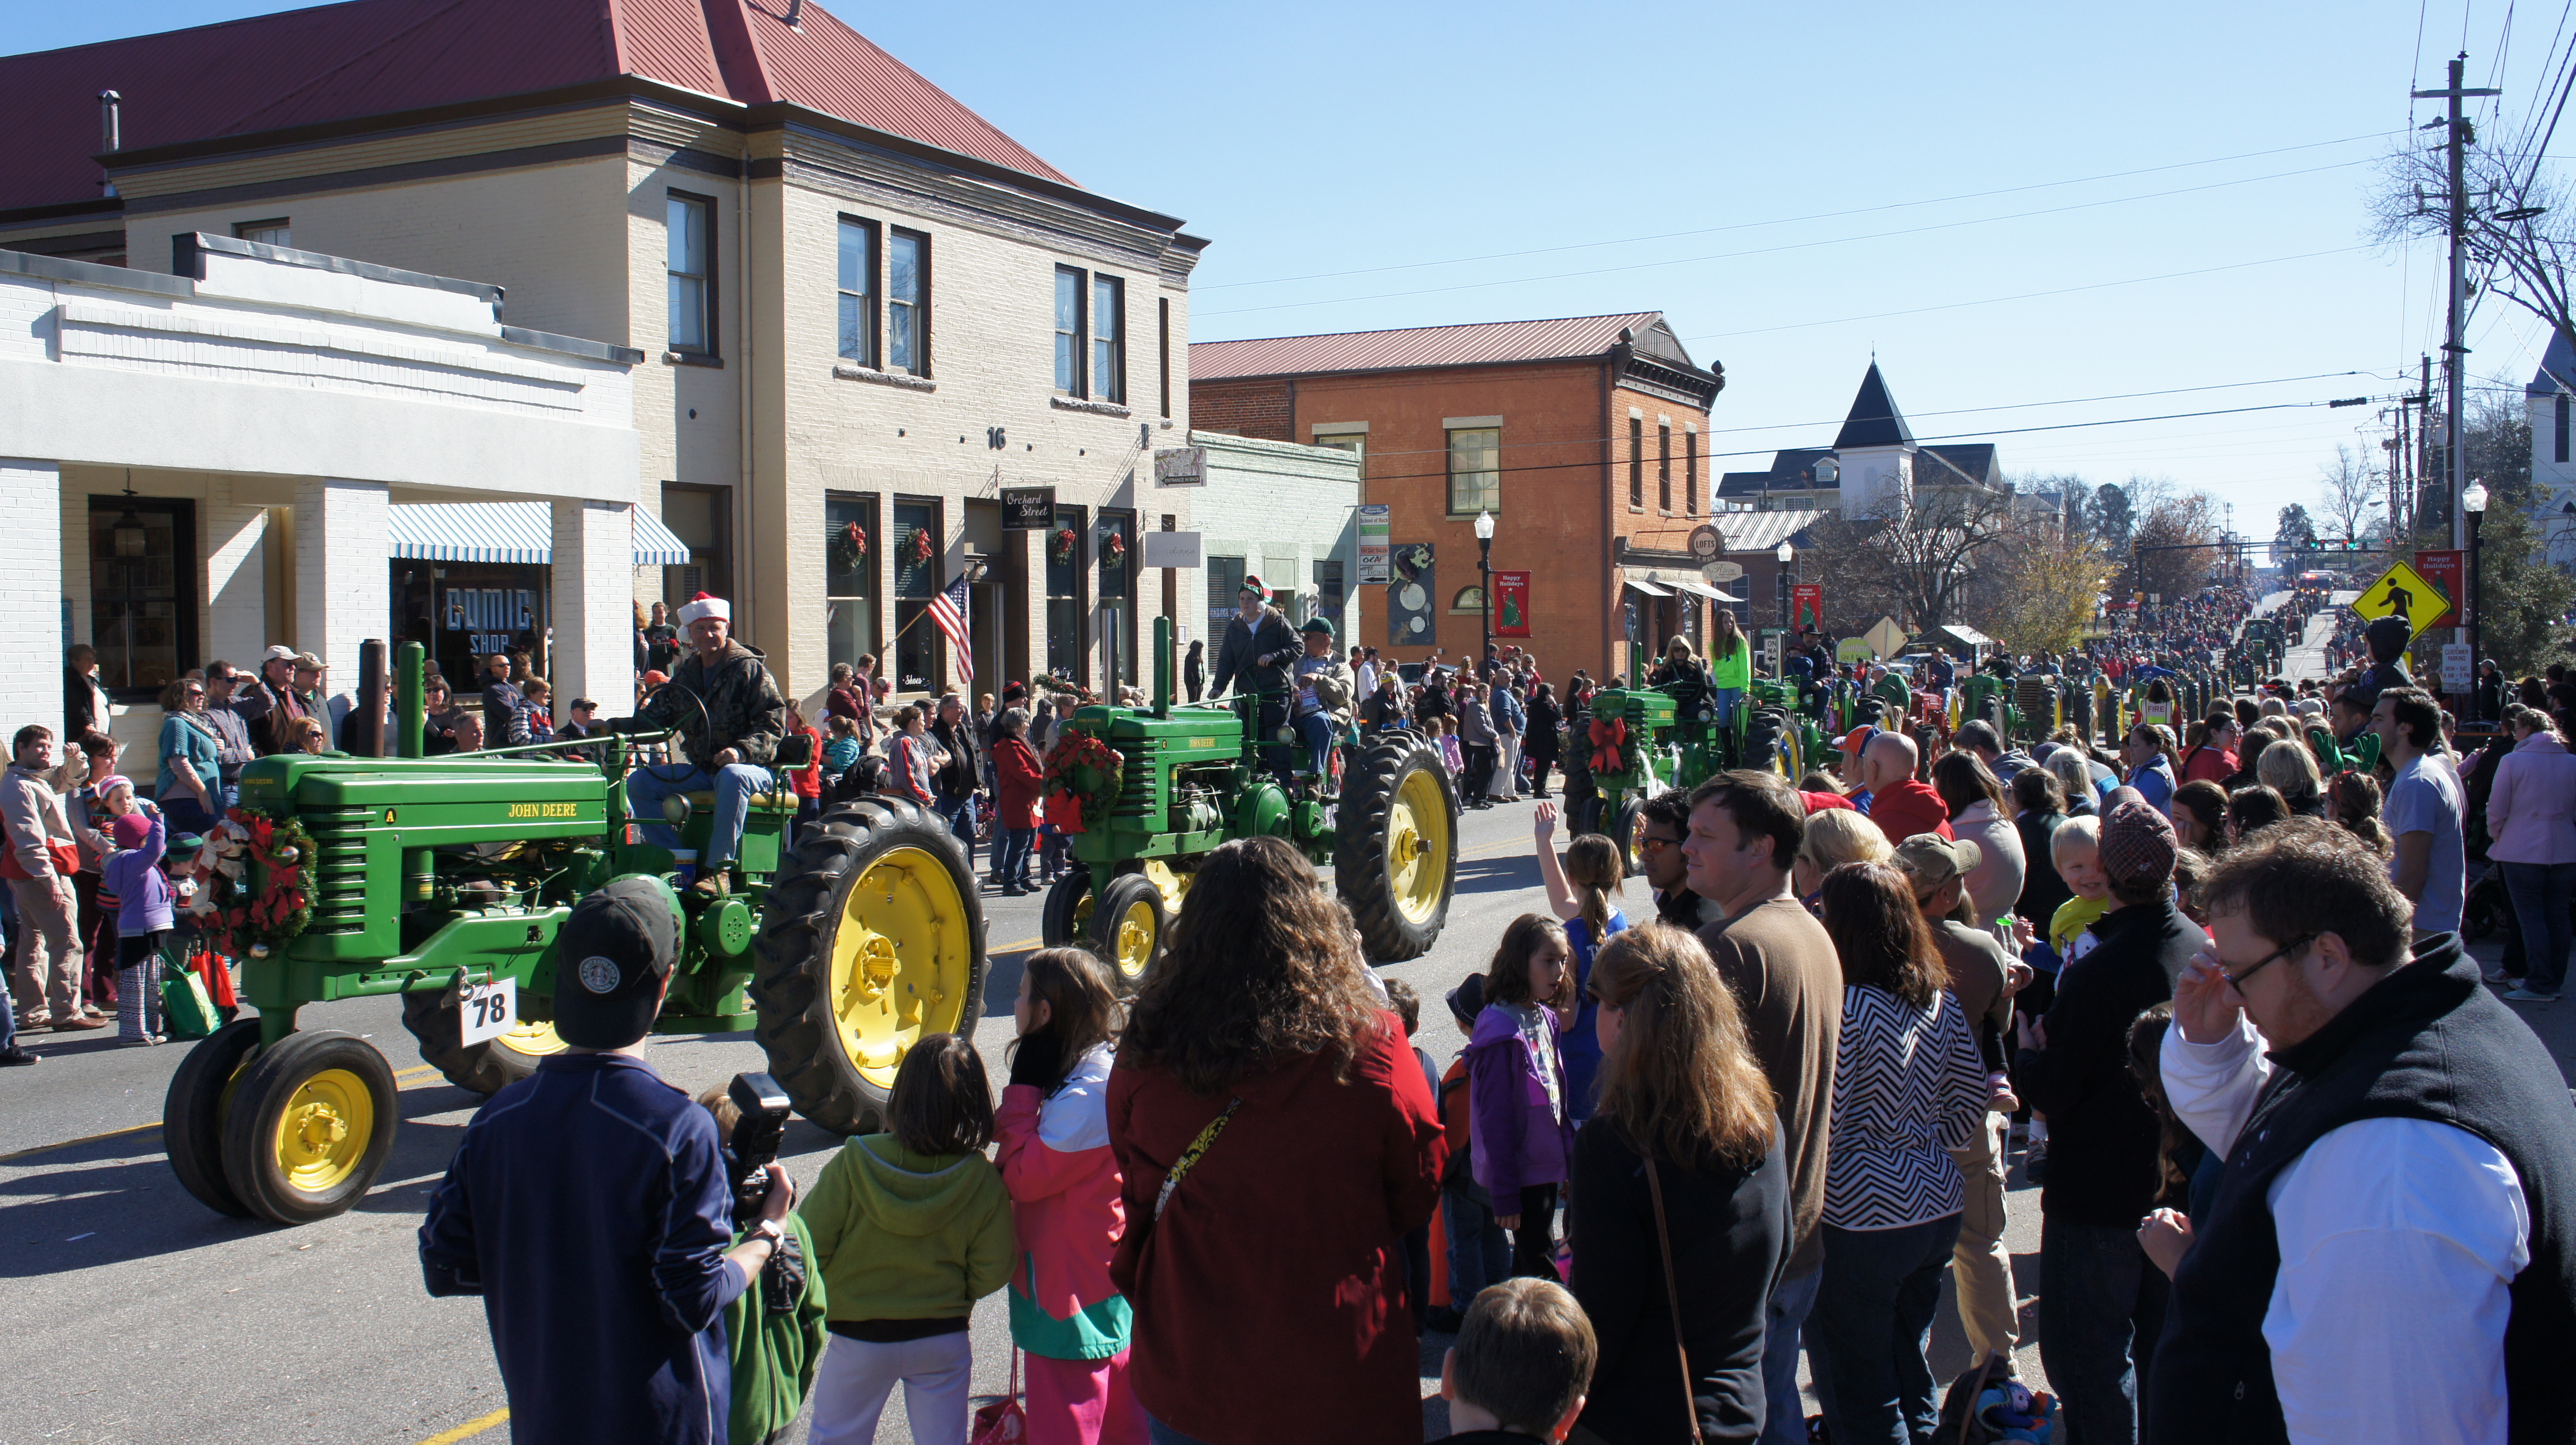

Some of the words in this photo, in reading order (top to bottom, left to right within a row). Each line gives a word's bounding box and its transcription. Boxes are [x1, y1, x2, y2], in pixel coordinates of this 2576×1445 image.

[987, 426, 1006, 450] 16
[1008, 493, 1043, 505] Orchard
[1020, 505, 1048, 517] Street
[1702, 554, 1717, 563] MAIN
[447, 588, 530, 631] COMIC
[470, 634, 509, 654] SHOP
[905, 674, 923, 685] Shoes
[1189, 739, 1200, 747] JOHN
[1201, 738, 1215, 747] DEERE
[509, 804, 540, 817] JOHN
[542, 803, 577, 817] DEERE
[385, 811, 395, 822] A
[473, 993, 505, 1029] 78
